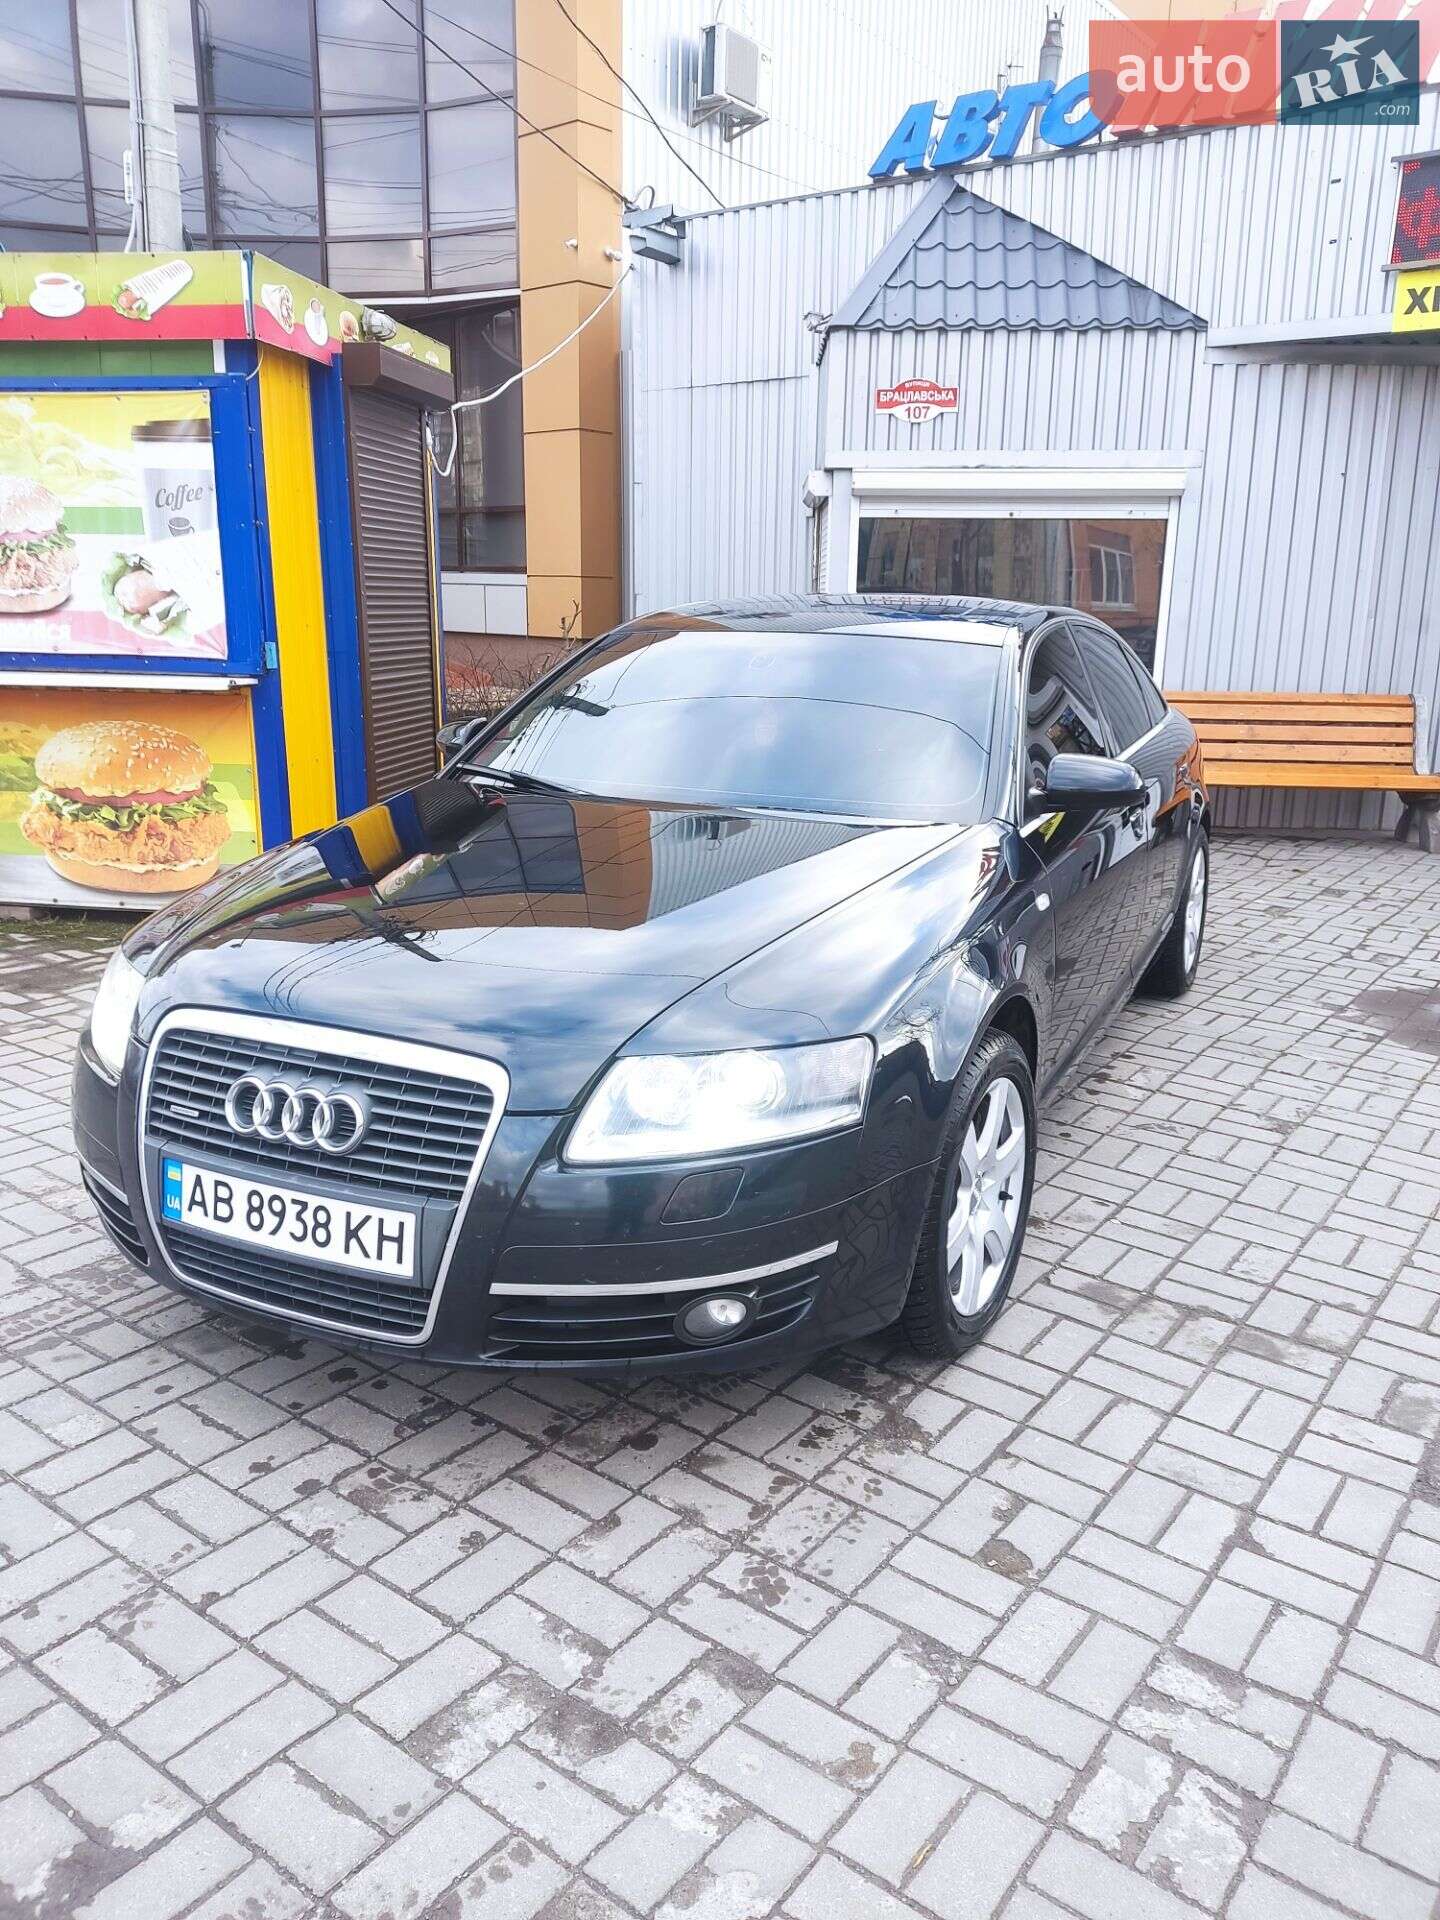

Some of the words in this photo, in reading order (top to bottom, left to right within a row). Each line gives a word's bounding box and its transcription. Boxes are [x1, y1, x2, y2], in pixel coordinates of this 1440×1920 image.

[880, 391, 954, 402] БРАЦЛАВСЬКА
[905, 406, 930, 419] 107
[155, 484, 203, 511] Coffee
[166, 1194, 181, 1210] UA
[246, 1190, 332, 1248] 8938
